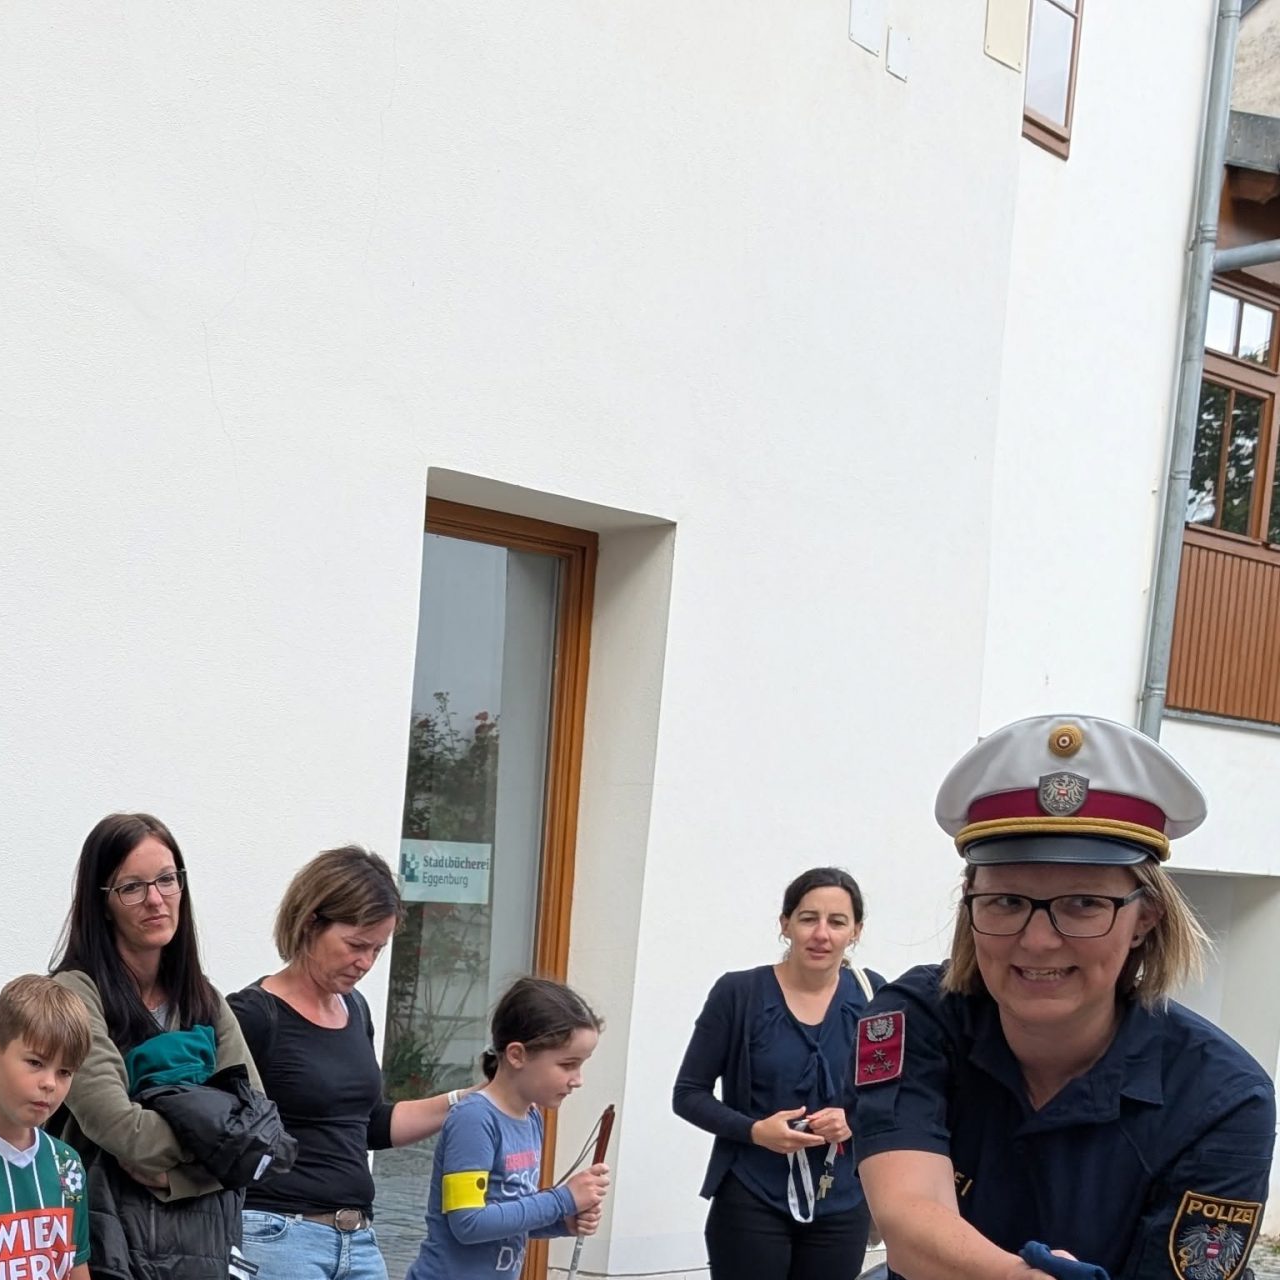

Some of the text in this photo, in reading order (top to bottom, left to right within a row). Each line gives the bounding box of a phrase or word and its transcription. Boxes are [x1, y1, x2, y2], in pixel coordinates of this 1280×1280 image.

[423, 855, 490, 870] Stadtbücherei
[423, 871, 469, 888] Eggenburg
[1186, 1200, 1255, 1224] POLIZEI
